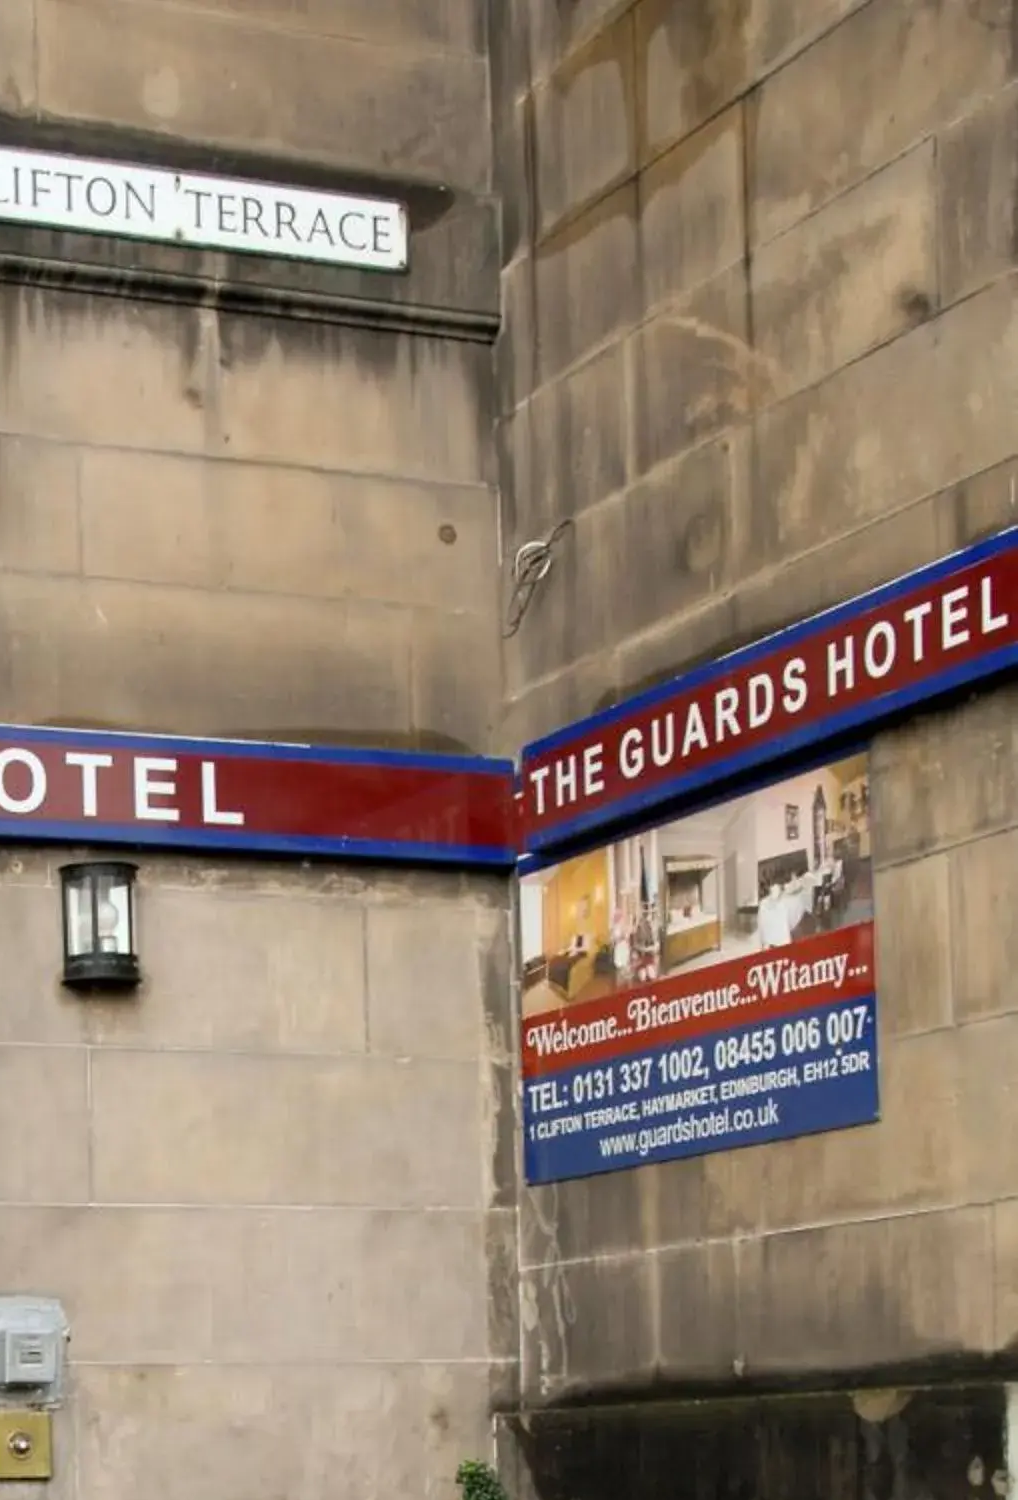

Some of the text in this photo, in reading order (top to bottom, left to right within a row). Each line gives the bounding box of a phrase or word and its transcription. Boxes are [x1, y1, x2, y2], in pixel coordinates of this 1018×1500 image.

[183, 188, 393, 253] TERRACE
[530, 575, 1009, 815] THE GUARDS HOTEL
[528, 1005, 868, 1113] TEL: 0131 337 1002, 08455 006 007
[537, 1118, 582, 1140] CLIFTON
[584, 1102, 640, 1131] TERRACE,
[642, 1086, 719, 1117] HAYMARKET,
[721, 1068, 800, 1100] EDINBURGH,
[803, 1058, 839, 1083] EH12
[840, 1051, 871, 1073] 5DR
[599, 1098, 779, 1157] www.guardshotel.co.uk
